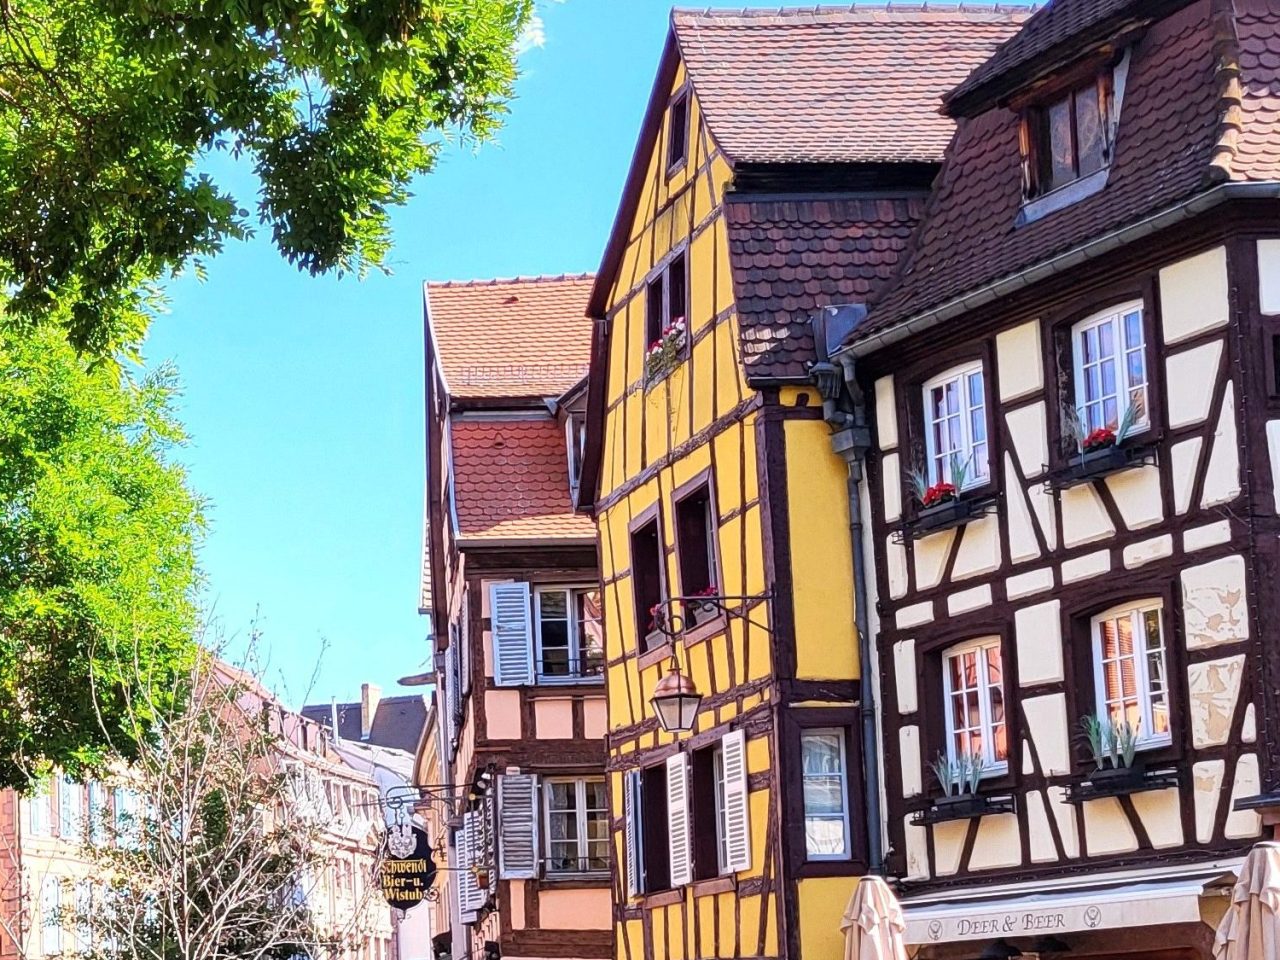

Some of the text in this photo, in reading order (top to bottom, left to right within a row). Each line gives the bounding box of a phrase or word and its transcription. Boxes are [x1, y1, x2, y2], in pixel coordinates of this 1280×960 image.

[383, 887, 423, 901] Wistub
[958, 913, 1066, 936] DEER & BEER
